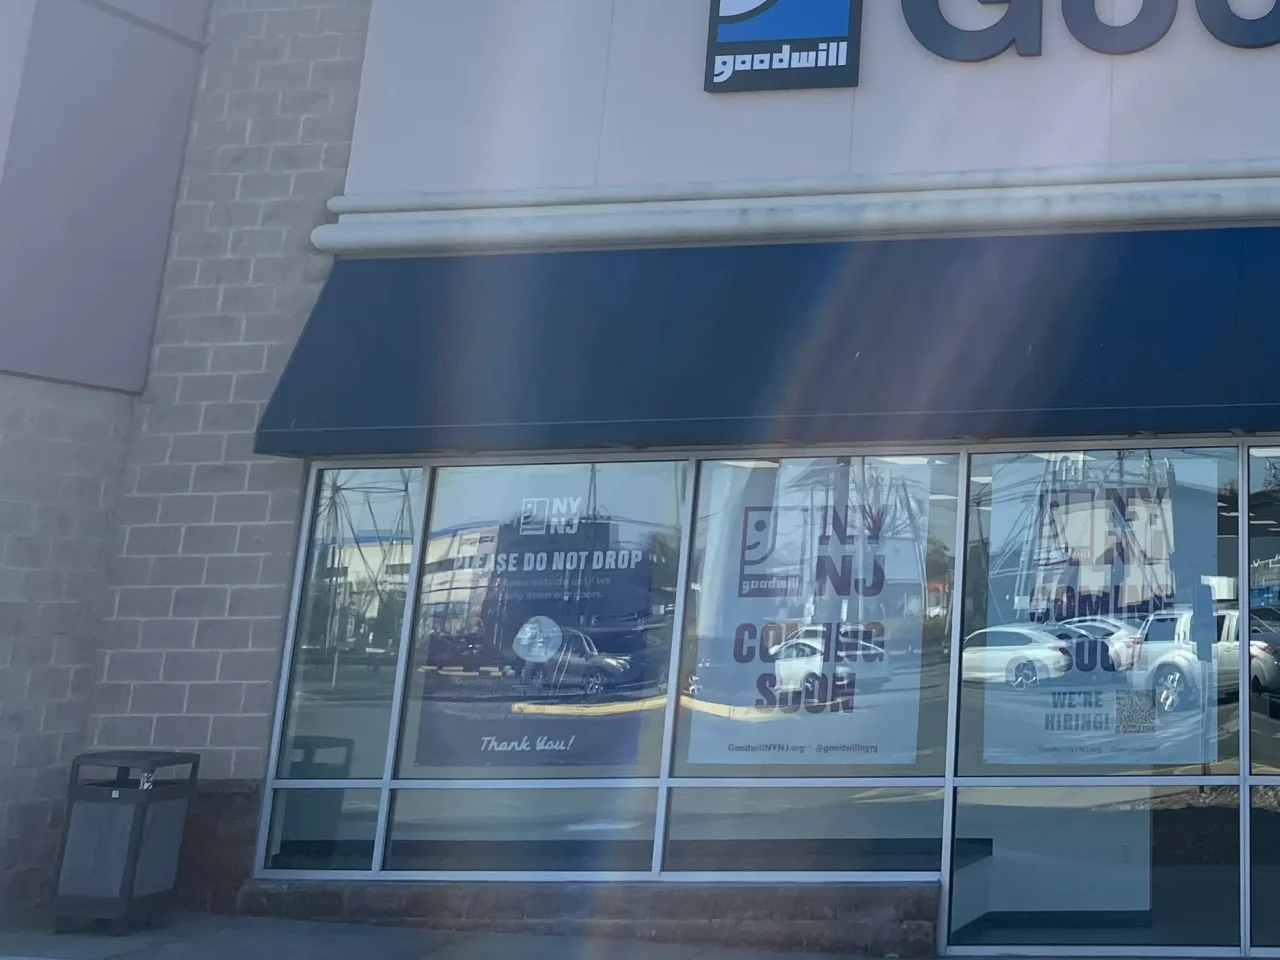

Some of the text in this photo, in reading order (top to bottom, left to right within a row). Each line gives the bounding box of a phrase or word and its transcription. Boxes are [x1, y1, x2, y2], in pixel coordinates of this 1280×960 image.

[712, 41, 847, 83] goodwill
[551, 496, 582, 515] NY
[550, 516, 580, 535] NJ
[819, 505, 892, 545] NY
[523, 552, 549, 571] DO
[552, 551, 590, 571] NOT
[592, 549, 643, 570] DROP
[741, 576, 800, 594] goodwill
[814, 554, 886, 597] NJ
[1051, 691, 1104, 709] WE'RE
[1044, 713, 1110, 732] HIRING!
[480, 734, 576, 752] Thank You!
[727, 743, 878, 753] GoodwillNYNJ.org @goodwillnynj
